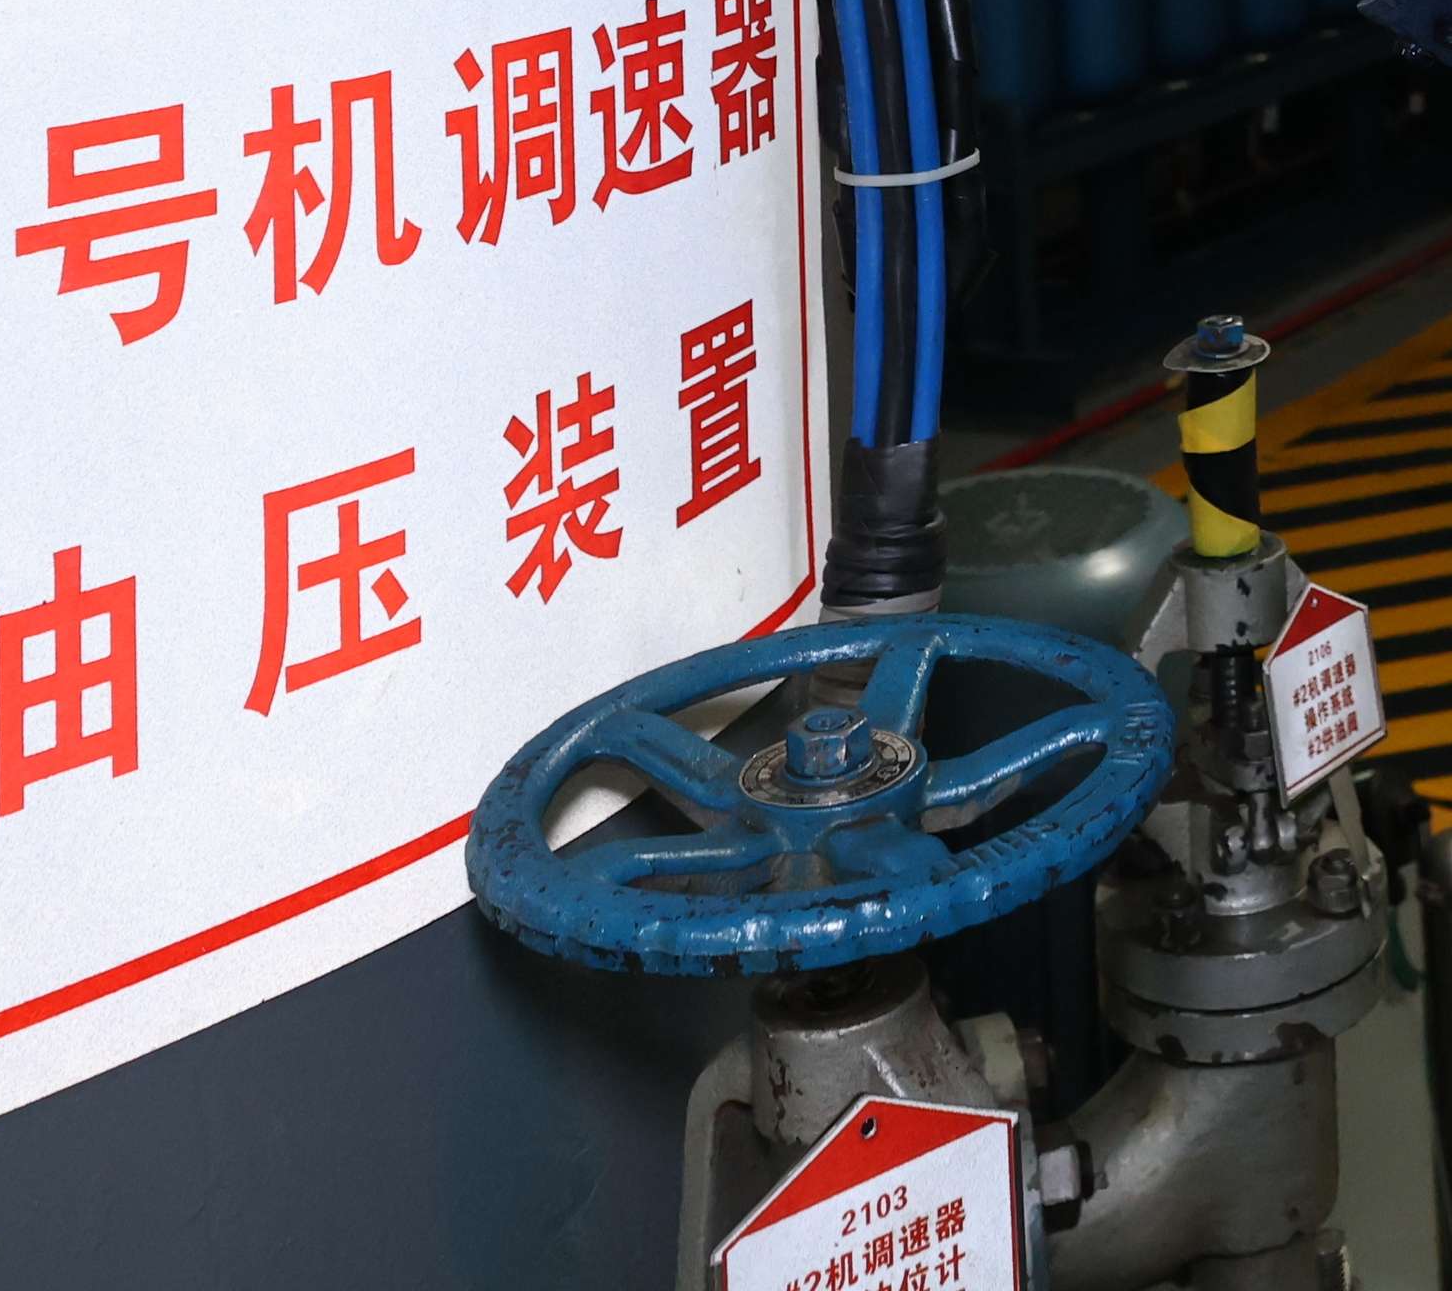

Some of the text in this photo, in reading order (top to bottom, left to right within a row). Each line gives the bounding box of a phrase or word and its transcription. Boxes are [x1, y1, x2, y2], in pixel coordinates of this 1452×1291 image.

[1291, 651, 1358, 708] #2机调速器
[1307, 639, 1333, 667] 2106
[840, 1184, 910, 1237] 2103
[785, 1196, 968, 1291] #2机调速器
